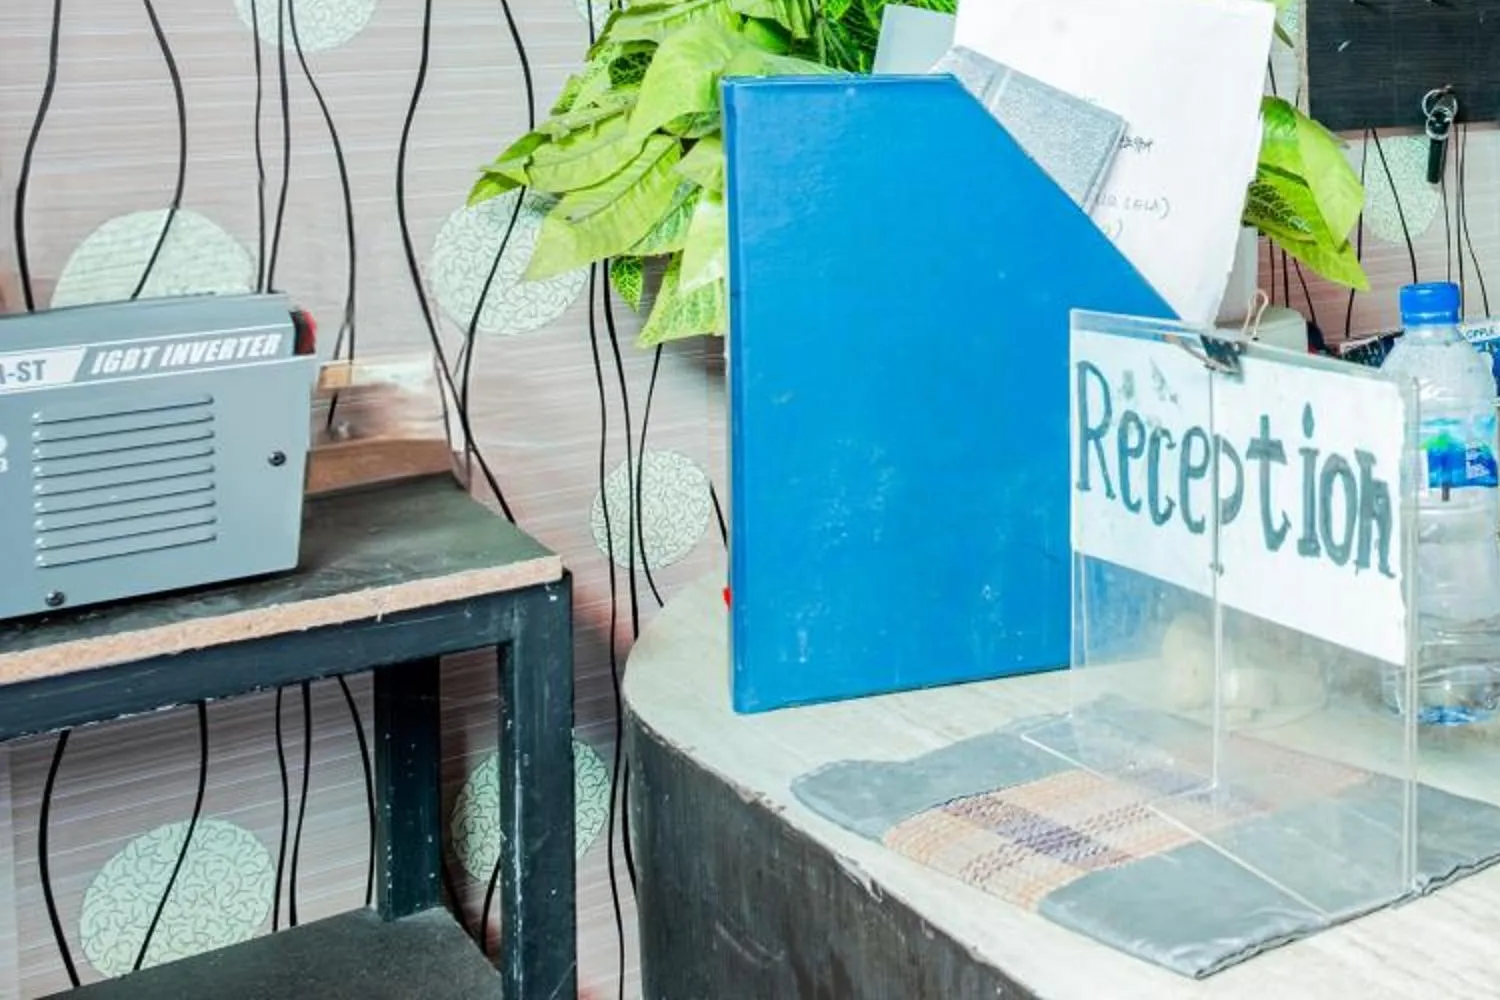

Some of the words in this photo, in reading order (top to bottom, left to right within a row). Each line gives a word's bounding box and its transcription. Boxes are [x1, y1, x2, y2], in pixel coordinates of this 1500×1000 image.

[91, 345, 156, 376] IGBT
[159, 333, 283, 367] INVERTER
[1076, 360, 1396, 580] Reception
